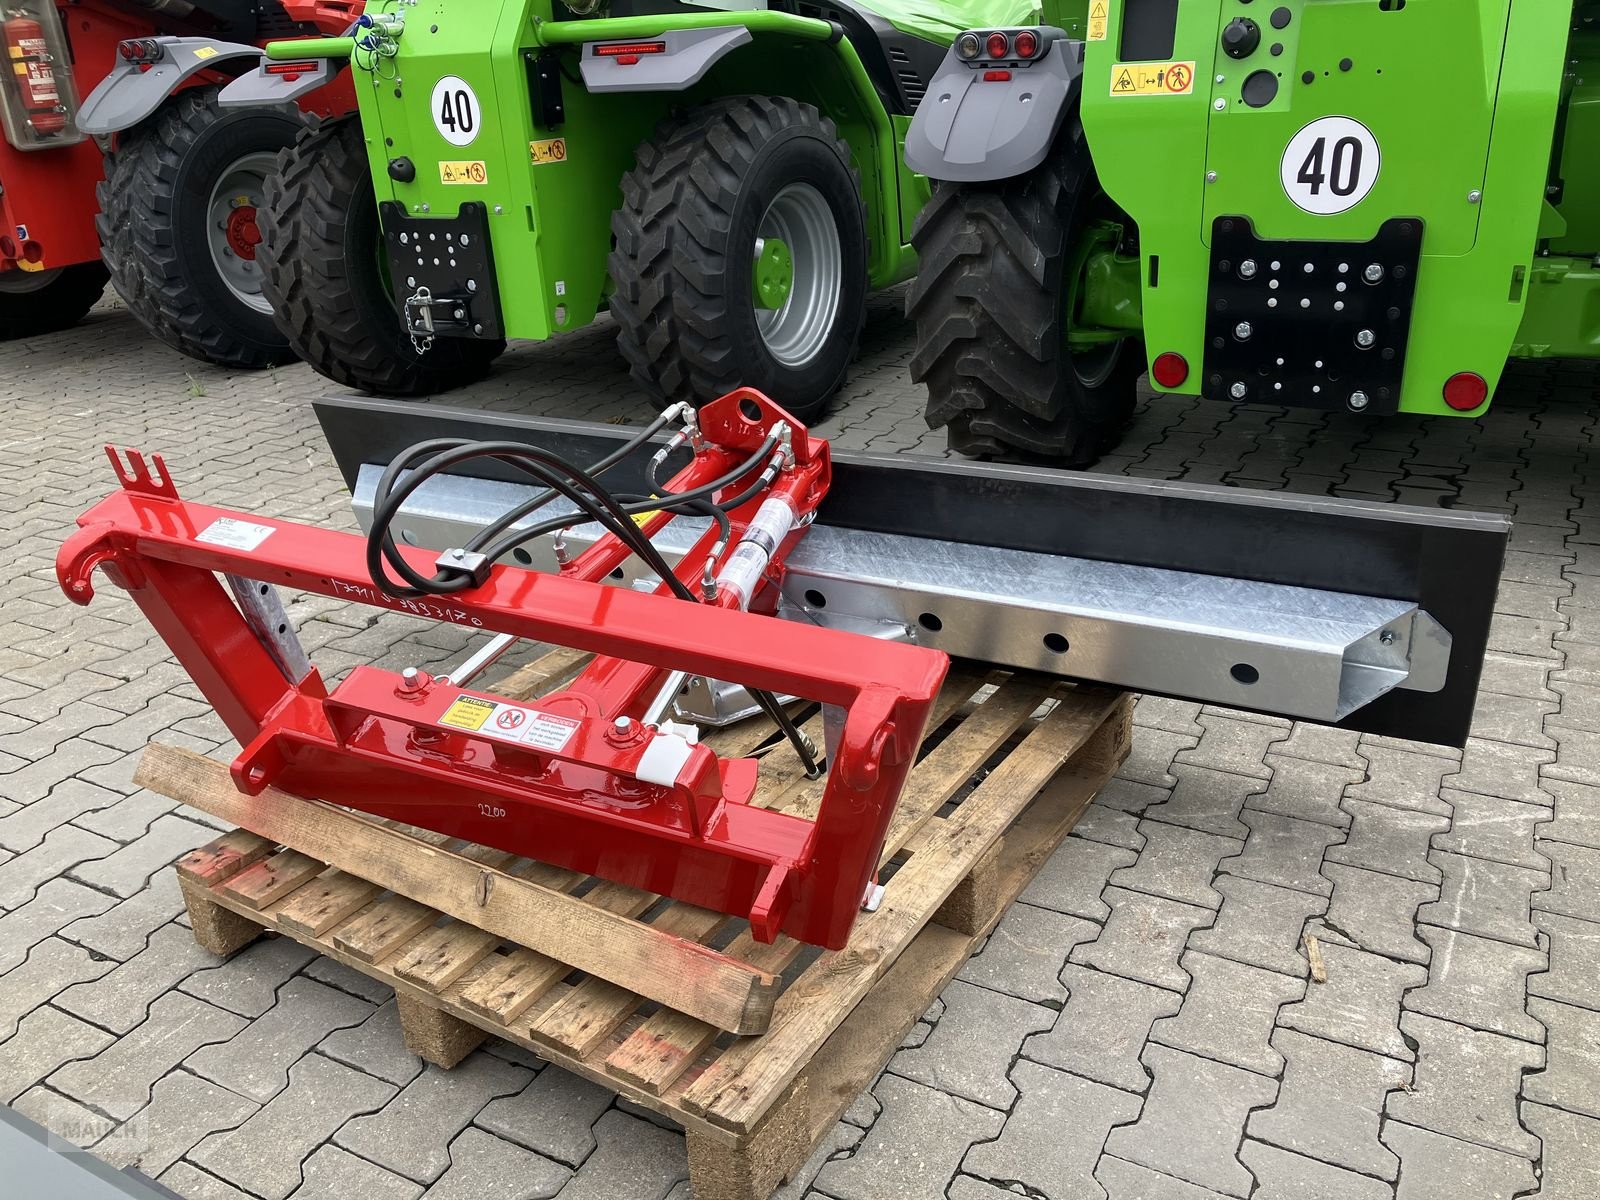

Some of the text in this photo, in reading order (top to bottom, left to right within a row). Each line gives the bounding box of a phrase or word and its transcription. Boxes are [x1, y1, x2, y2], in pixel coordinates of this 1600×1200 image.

[441, 89, 473, 133] 40
[1297, 136, 1363, 196] 40
[540, 715, 575, 728] VERBODEN
[477, 803, 506, 818] 2200
